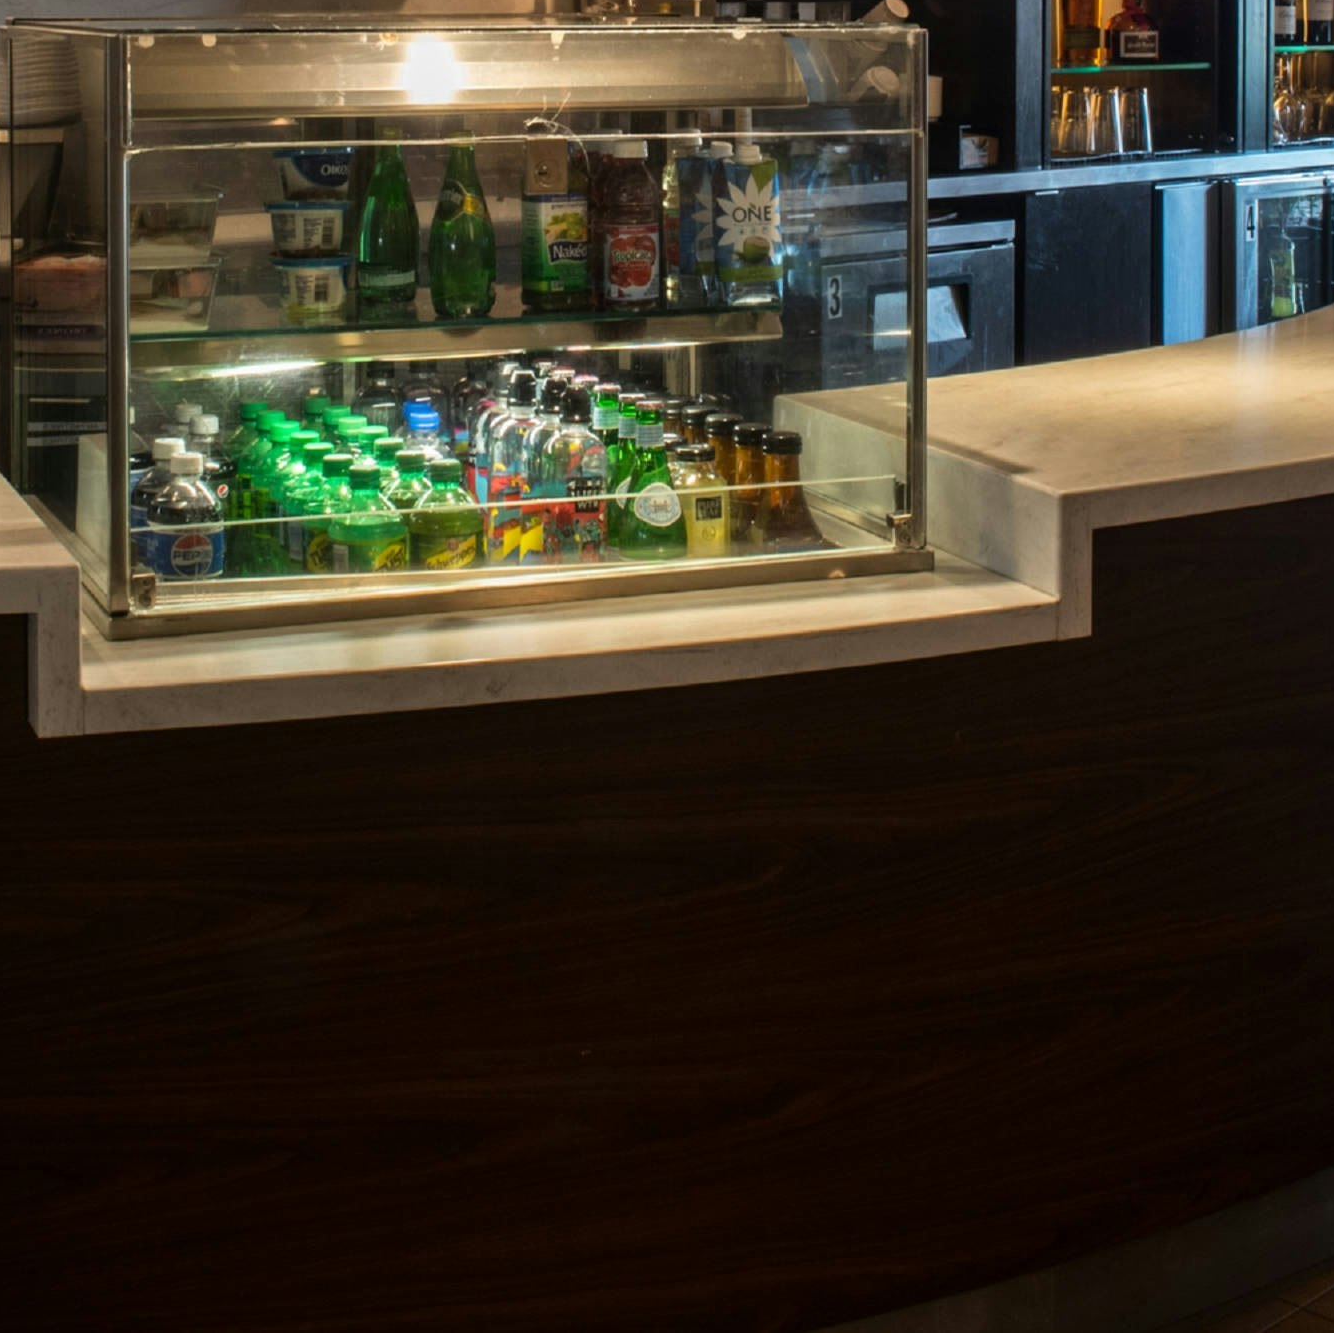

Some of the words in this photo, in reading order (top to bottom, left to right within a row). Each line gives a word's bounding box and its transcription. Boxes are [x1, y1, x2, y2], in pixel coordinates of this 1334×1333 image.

[732, 205, 773, 224] ONE
[1245, 205, 1256, 239] 4
[828, 277, 842, 316] 3
